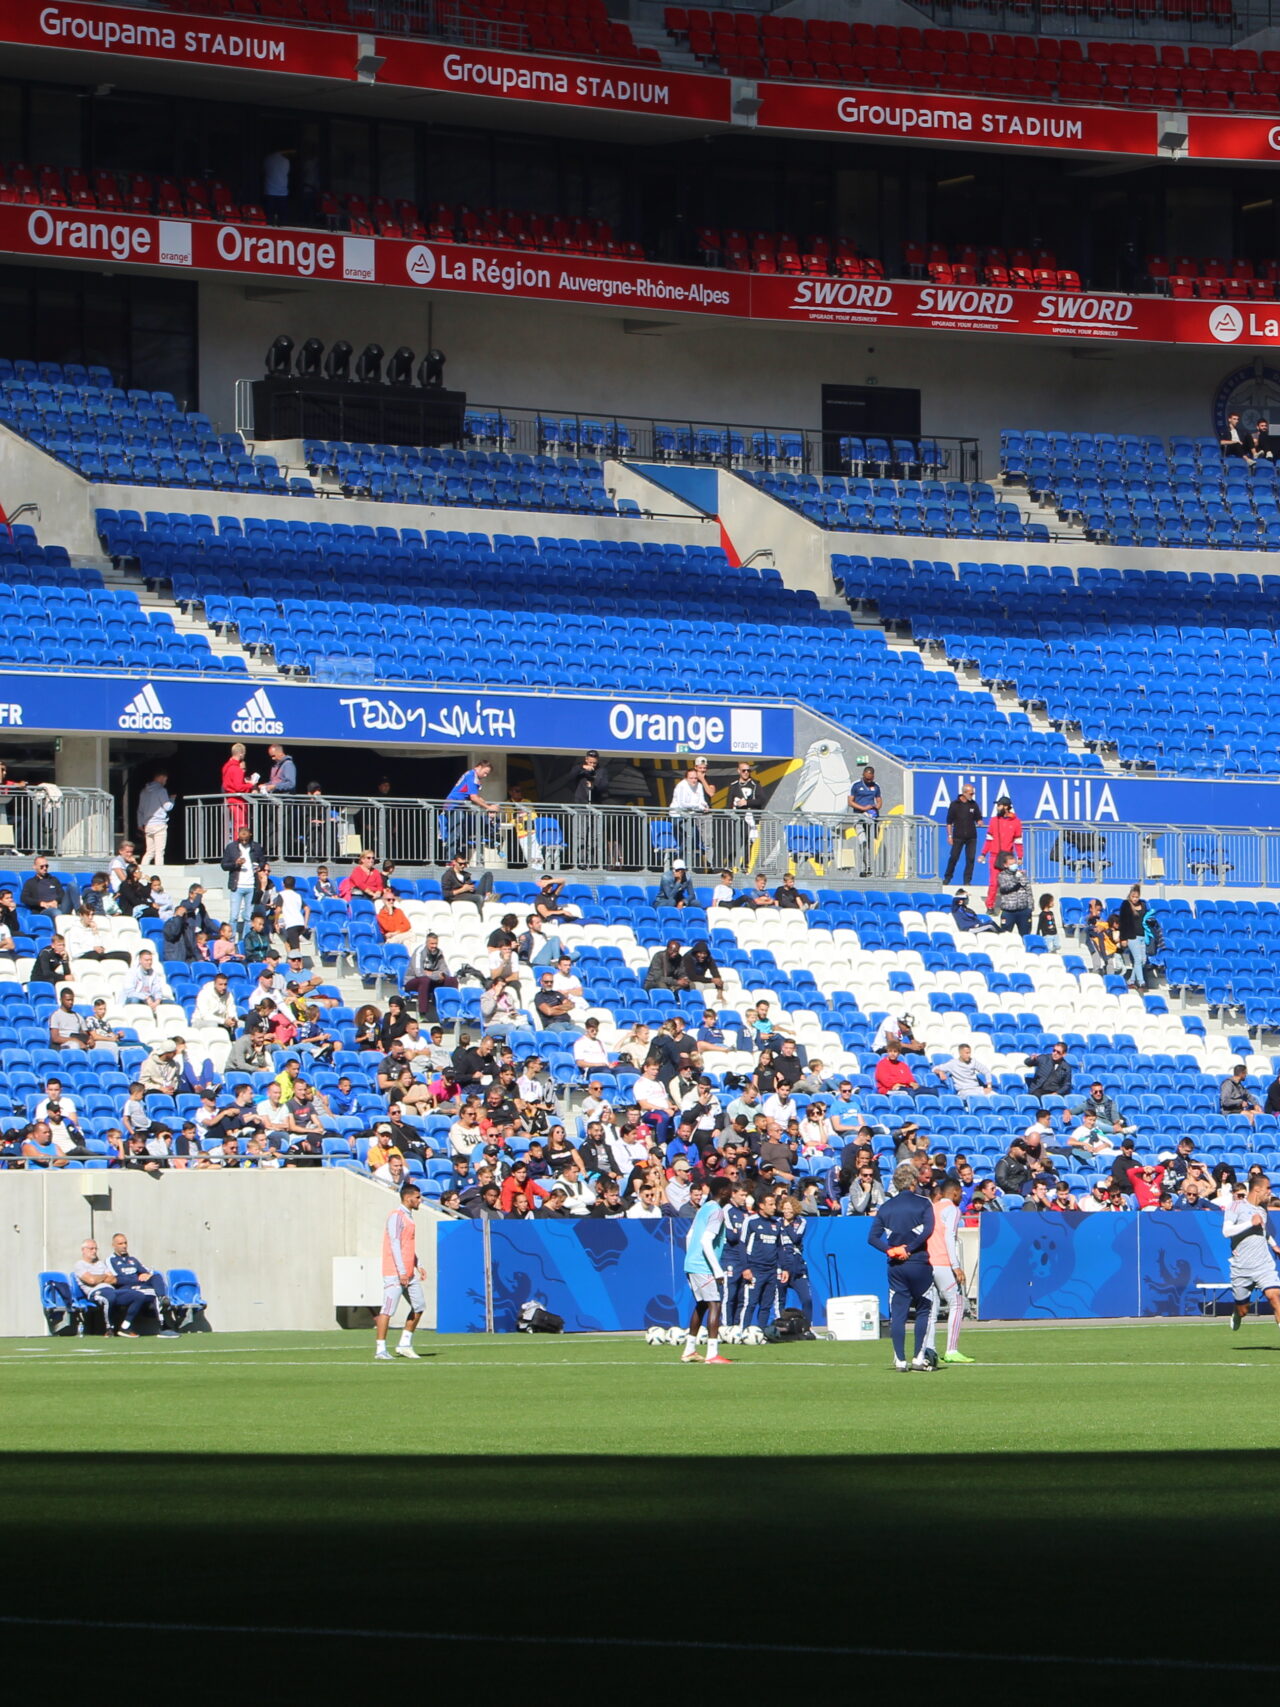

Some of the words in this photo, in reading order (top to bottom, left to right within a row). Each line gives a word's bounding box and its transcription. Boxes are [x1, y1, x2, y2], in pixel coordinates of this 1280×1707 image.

[39, 8, 175, 50] Groupama
[184, 32, 285, 61] STADIUM
[443, 54, 568, 95] Groupama
[575, 75, 669, 104] STADIUM
[837, 97, 972, 131] Groupama
[981, 113, 1082, 139] STADIUM
[27, 210, 151, 260] Orange
[216, 226, 336, 275] Orange
[161, 251, 189, 263] orange
[344, 267, 373, 279] orange
[441, 257, 466, 281] La
[472, 258, 551, 289] Région
[558, 272, 730, 305] Auvergne-Rhône-Alpes
[794, 281, 892, 308] SWORD
[916, 288, 1014, 315] SWORD
[1038, 295, 1133, 321] SWORD
[1249, 314, 1279, 337] La
[118, 713, 172, 731] adidas
[231, 718, 284, 736] adidas
[340, 698, 426, 737] TEDDY
[609, 704, 724, 750] Orange
[732, 741, 759, 751] orange
[929, 776, 1015, 817] AlA
